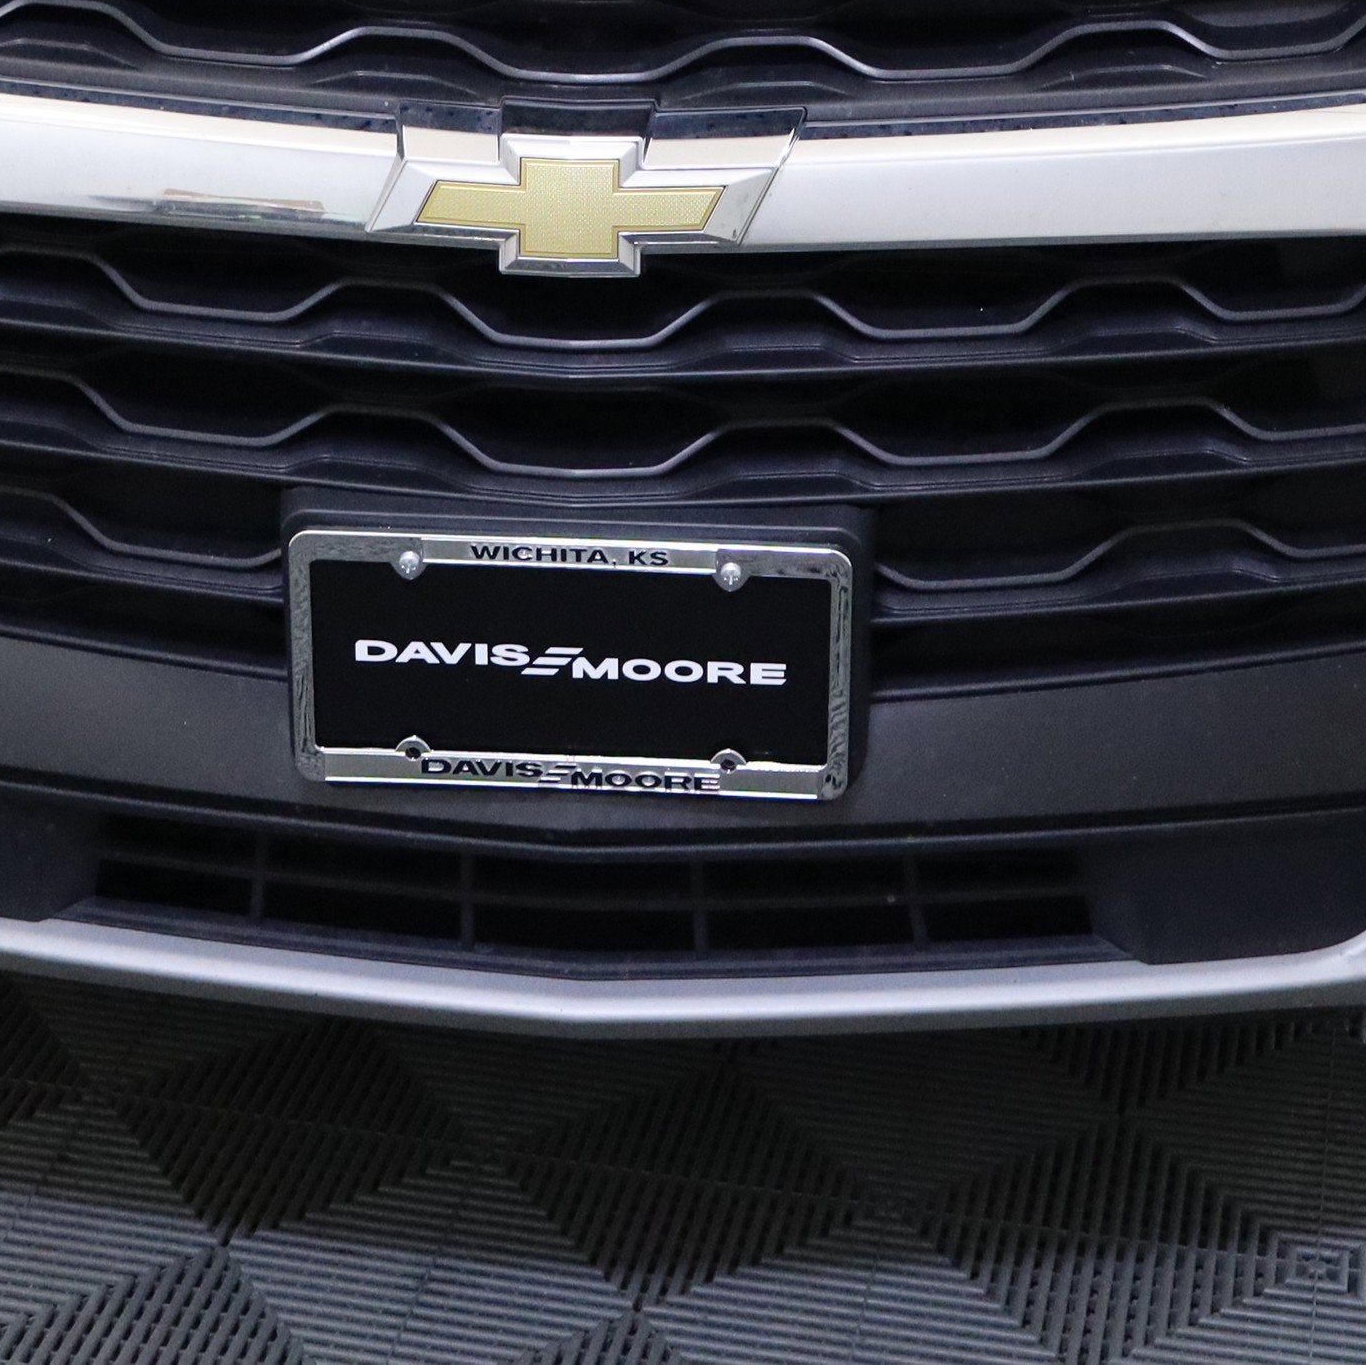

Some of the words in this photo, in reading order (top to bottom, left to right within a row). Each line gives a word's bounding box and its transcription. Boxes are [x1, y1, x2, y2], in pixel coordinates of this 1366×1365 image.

[629, 551, 669, 566] KS
[354, 639, 532, 667] DAVIS
[572, 656, 787, 686] MOORE
[420, 758, 543, 777] DAVIS
[570, 769, 720, 792] MOORE
